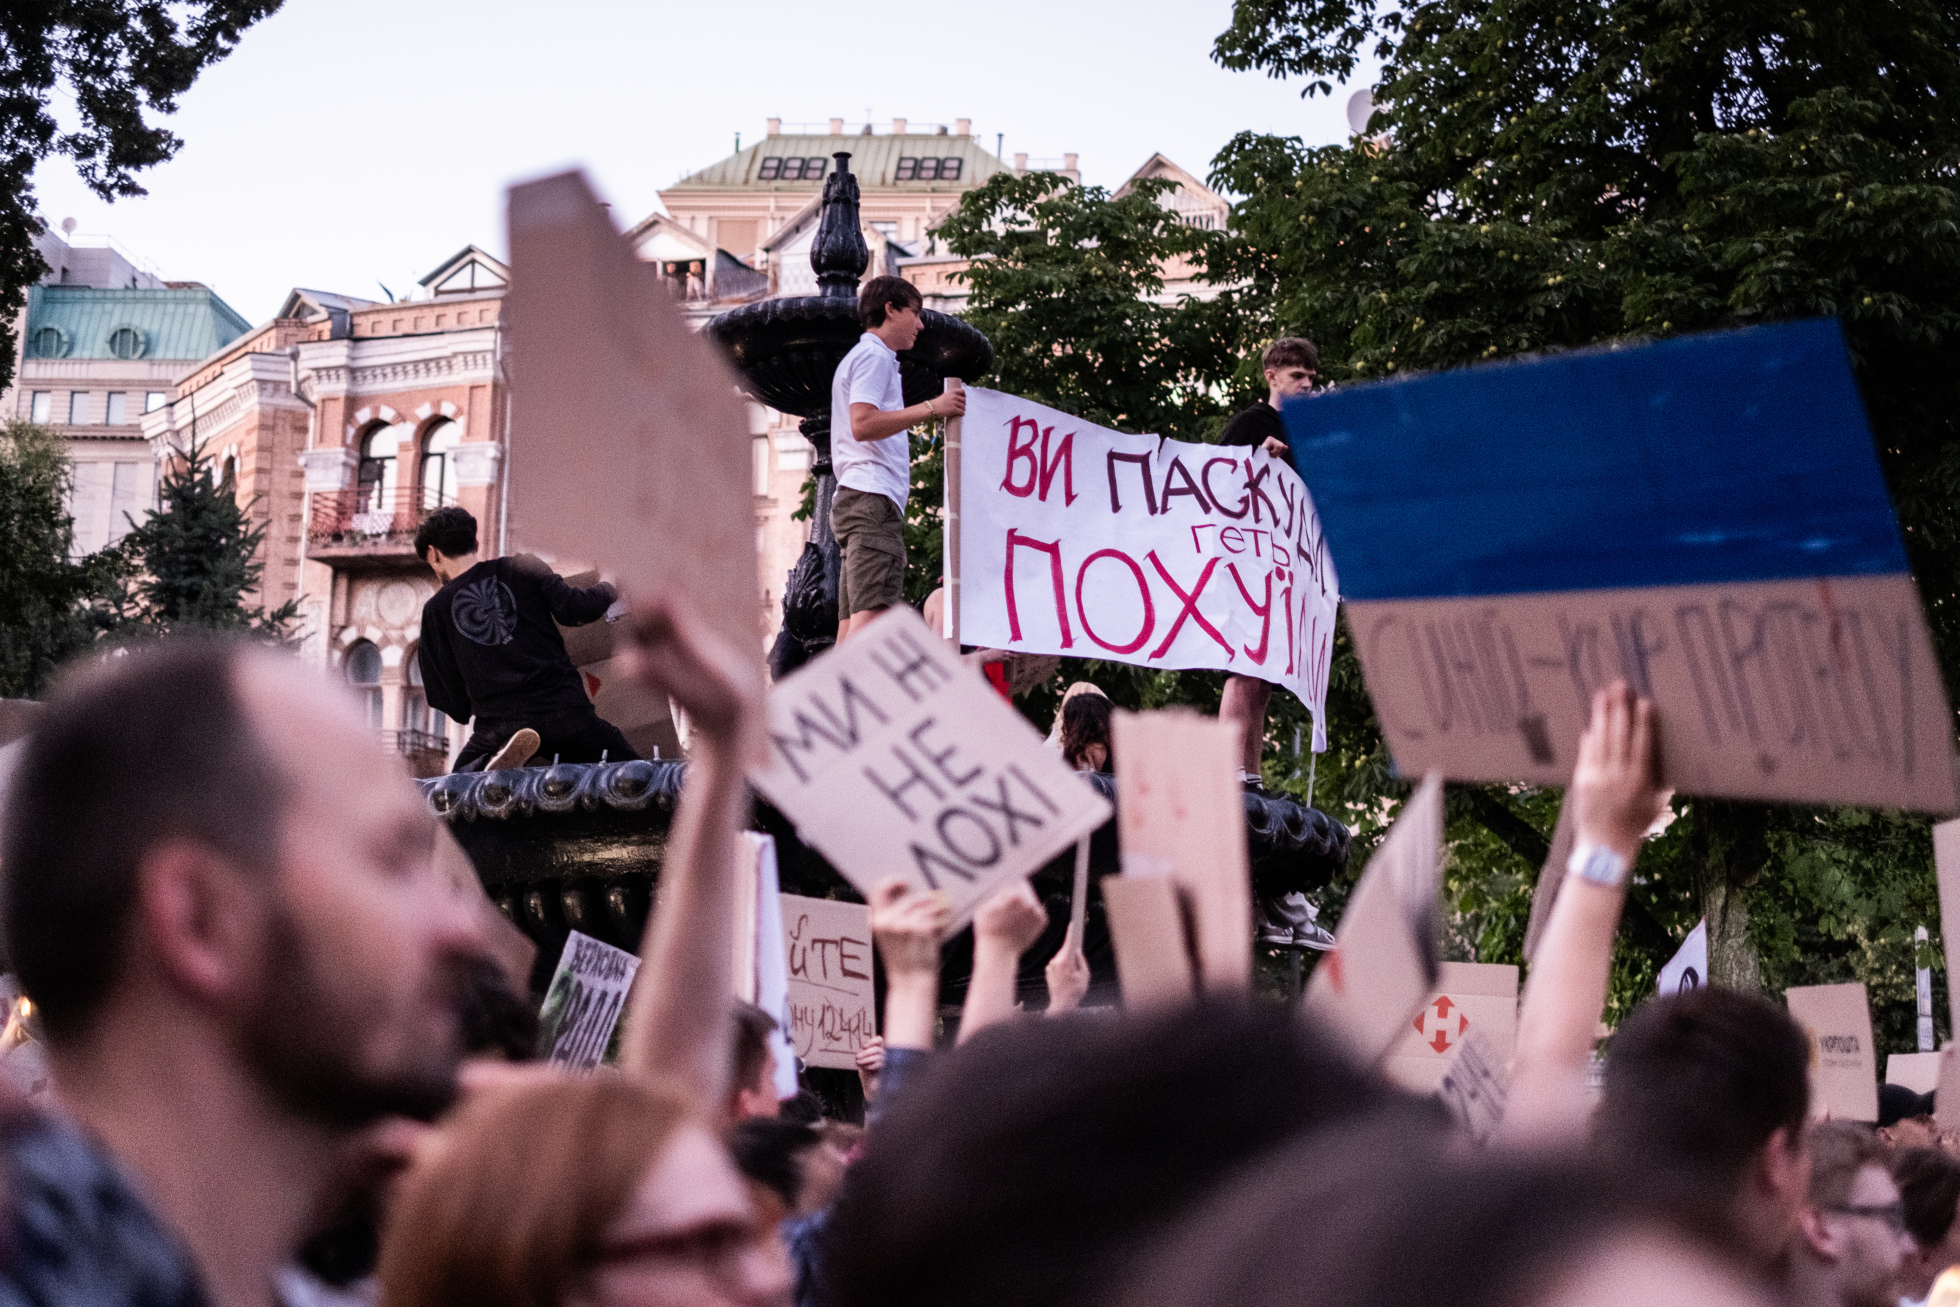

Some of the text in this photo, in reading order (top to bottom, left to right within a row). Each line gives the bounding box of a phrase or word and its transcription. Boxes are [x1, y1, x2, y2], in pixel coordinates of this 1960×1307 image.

[1000, 415, 1327, 597] ВИ ПАСКУДИ
[770, 671, 890, 784] МИ
[863, 716, 985, 823] НЕ
[909, 764, 1061, 890] ЛОХІ
